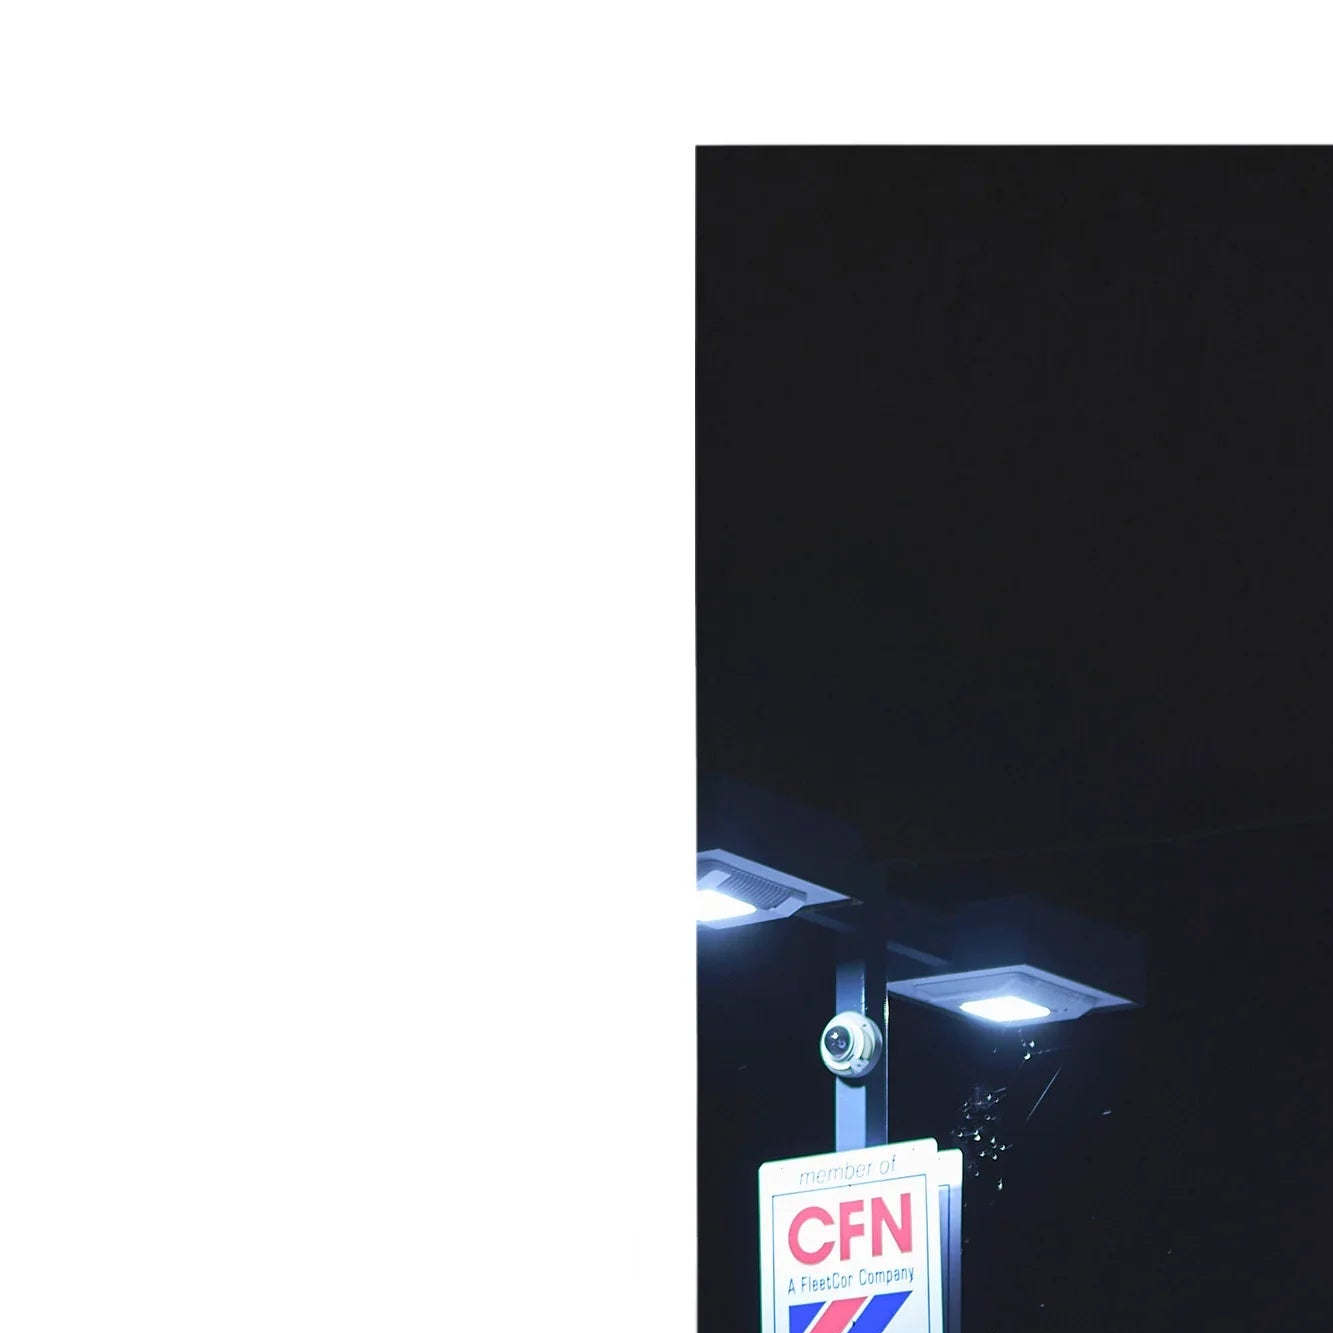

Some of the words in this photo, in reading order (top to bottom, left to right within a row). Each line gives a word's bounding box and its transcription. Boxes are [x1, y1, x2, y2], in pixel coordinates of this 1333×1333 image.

[800, 1161, 873, 1186] member
[879, 1154, 898, 1176] of
[788, 1193, 912, 1266] CFN
[788, 1277, 797, 1295] A
[801, 1272, 853, 1293] FleetCor
[859, 1266, 915, 1289] Company
